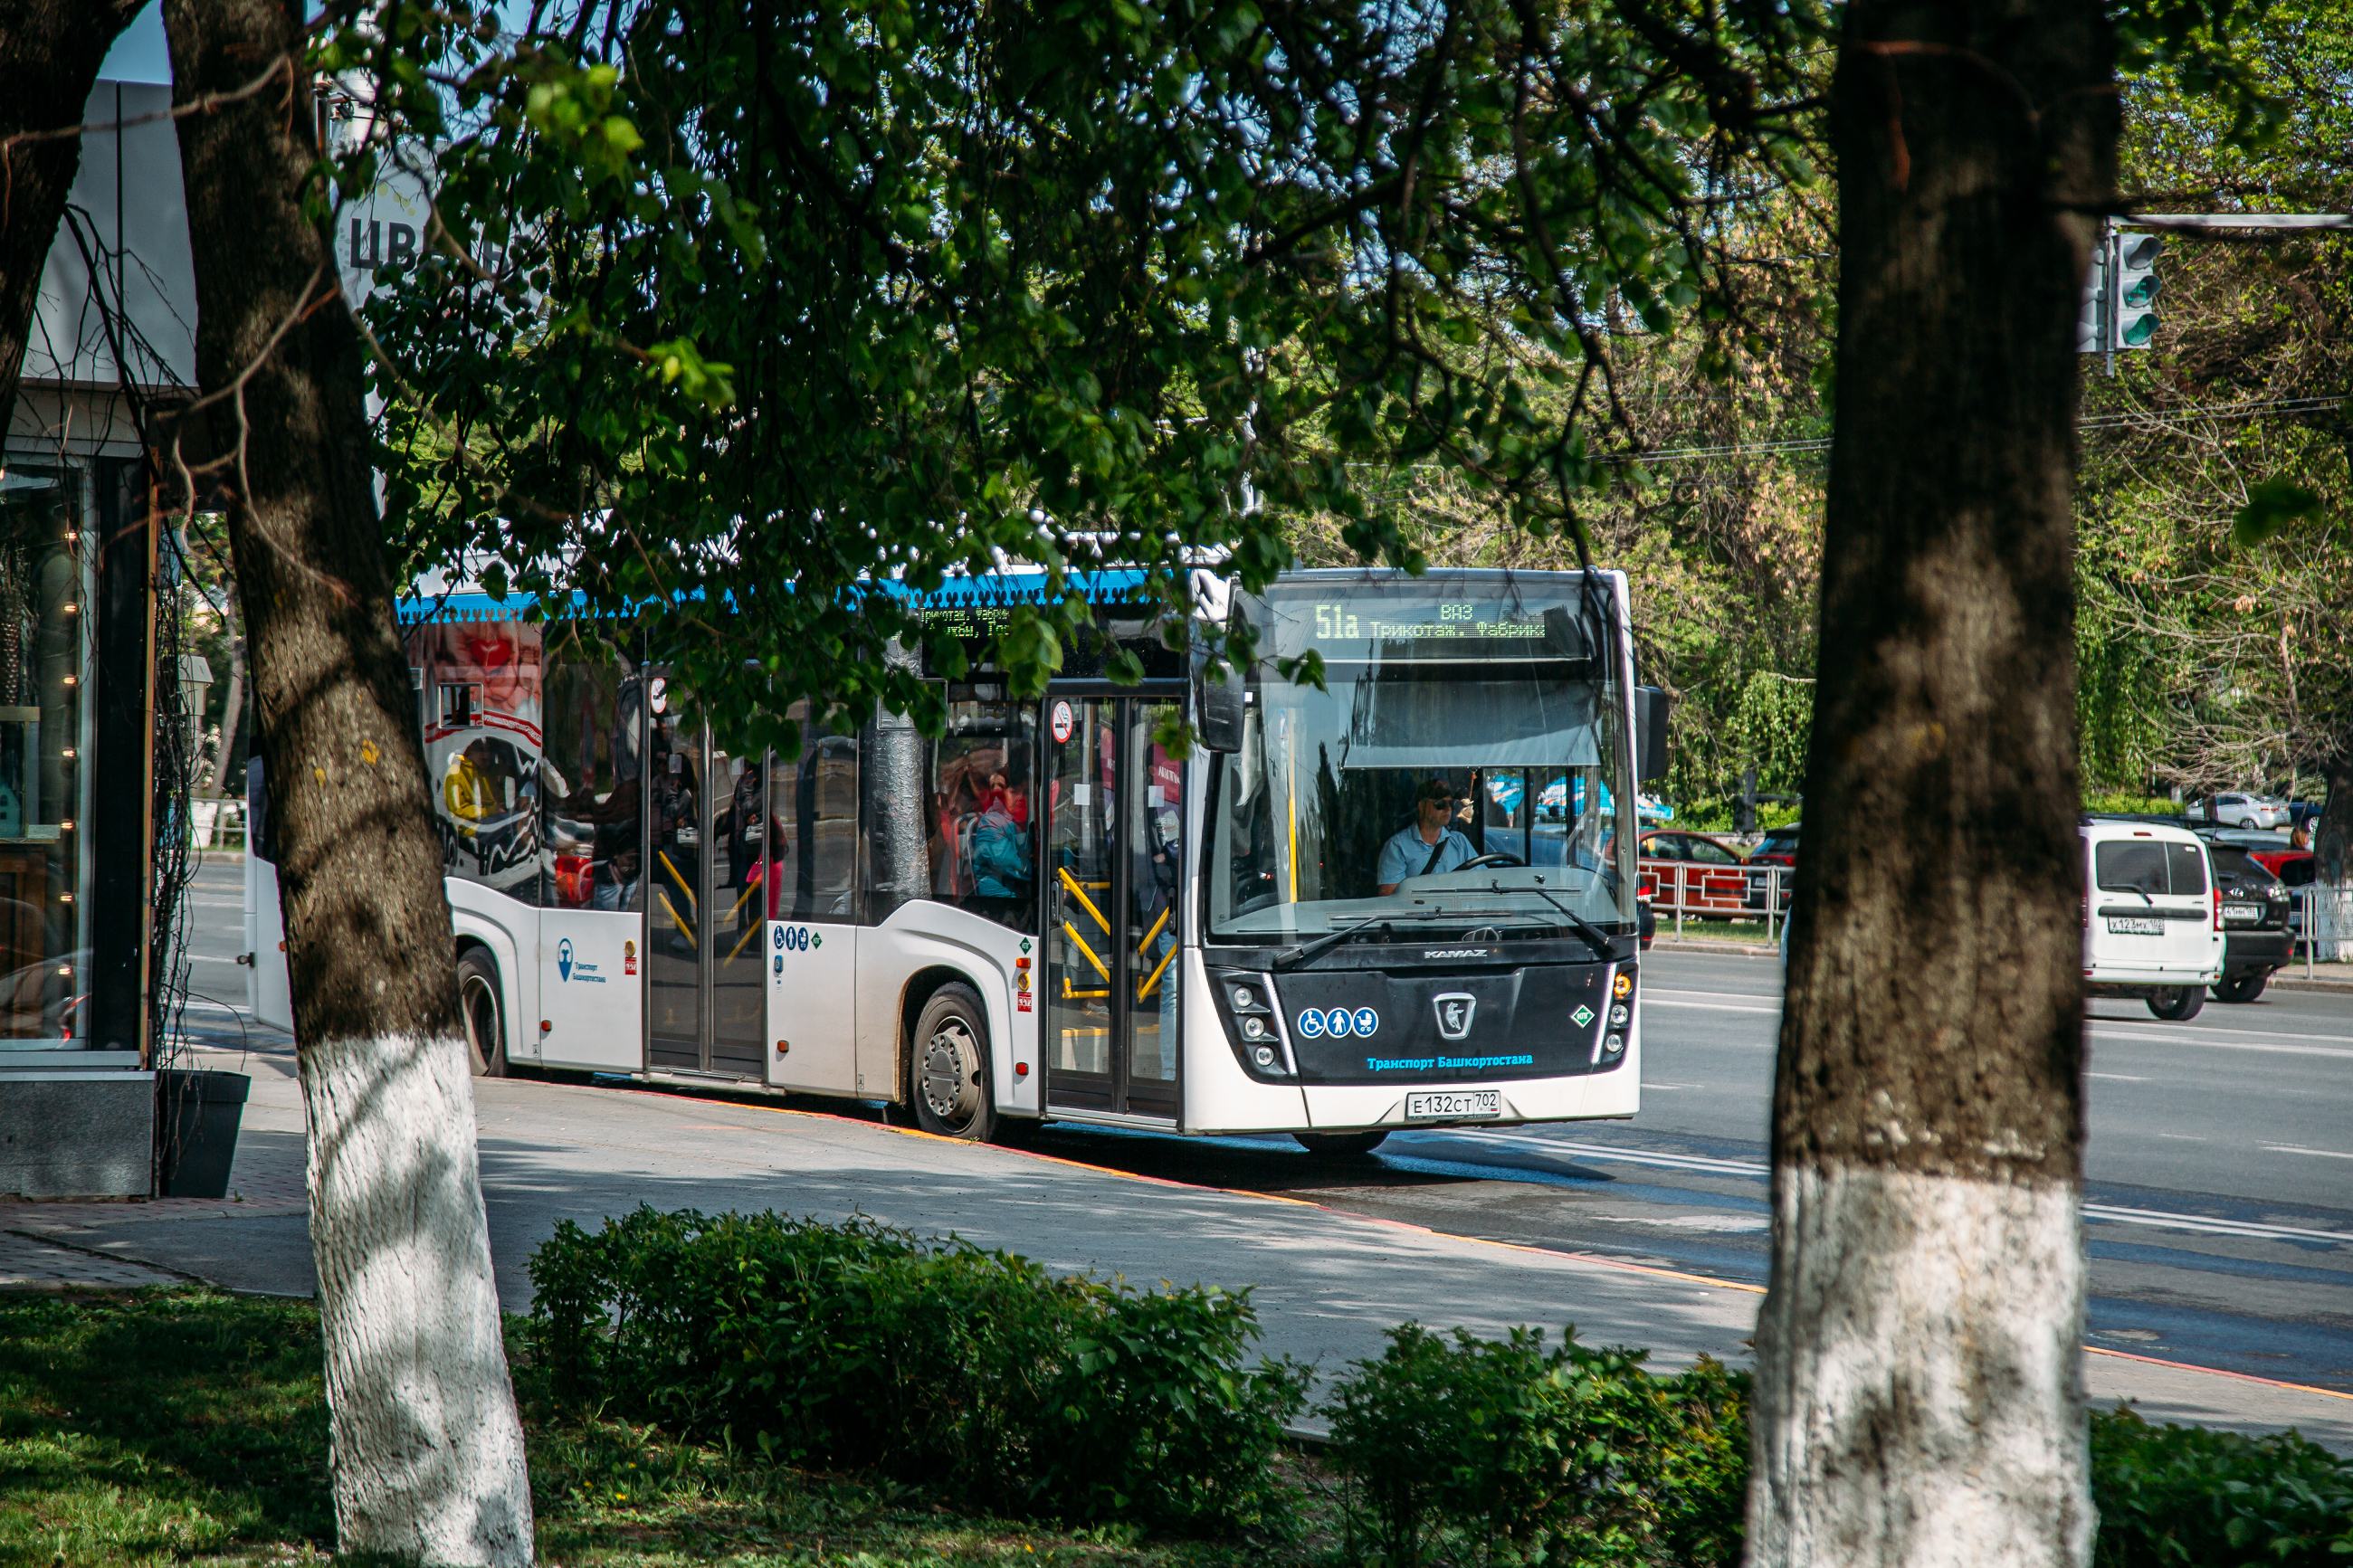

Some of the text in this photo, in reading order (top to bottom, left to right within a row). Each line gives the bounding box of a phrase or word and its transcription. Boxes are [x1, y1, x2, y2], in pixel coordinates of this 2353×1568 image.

[1441, 604, 1473, 621] ВАЗ
[1424, 949, 1489, 959] KAMAZ
[1577, 1012, 1590, 1021] КПГ
[1367, 1054, 1534, 1072] Транспорт Башкортостана
[1475, 1093, 1498, 1107] 702
